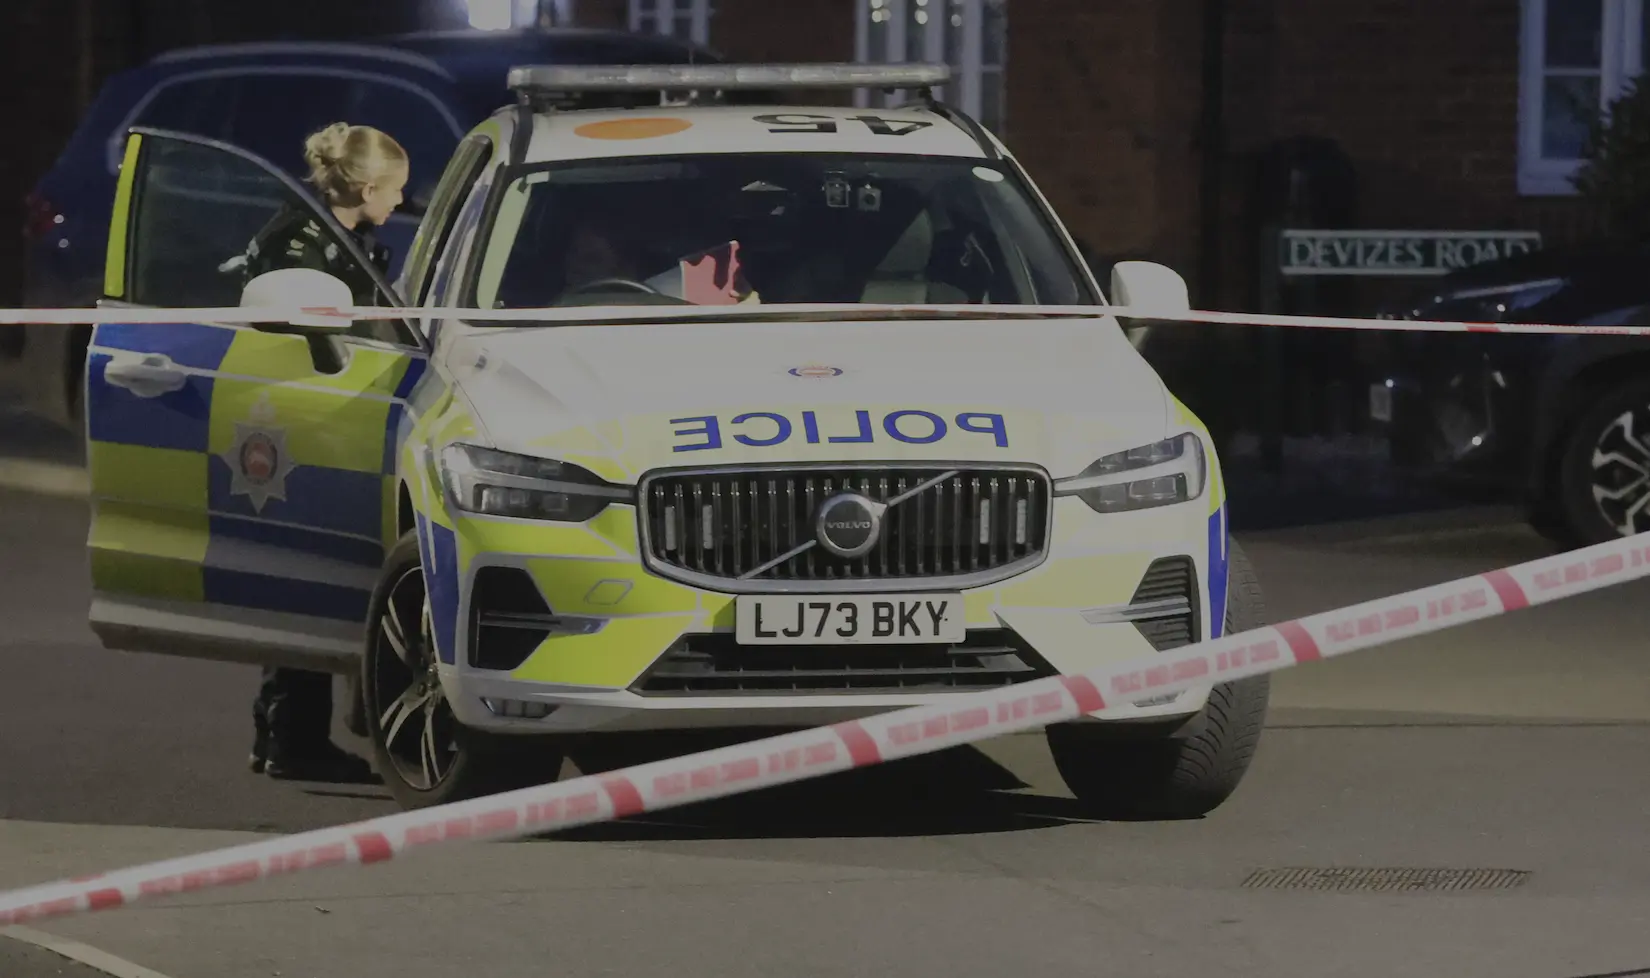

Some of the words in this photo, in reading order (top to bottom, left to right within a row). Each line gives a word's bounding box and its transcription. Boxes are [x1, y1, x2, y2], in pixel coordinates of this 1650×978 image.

[752, 113, 934, 136] 45
[1290, 237, 1424, 268] DEVIZES
[827, 521, 871, 530] VOLVO
[755, 602, 859, 638] LJ73
[872, 600, 948, 637] BKY
